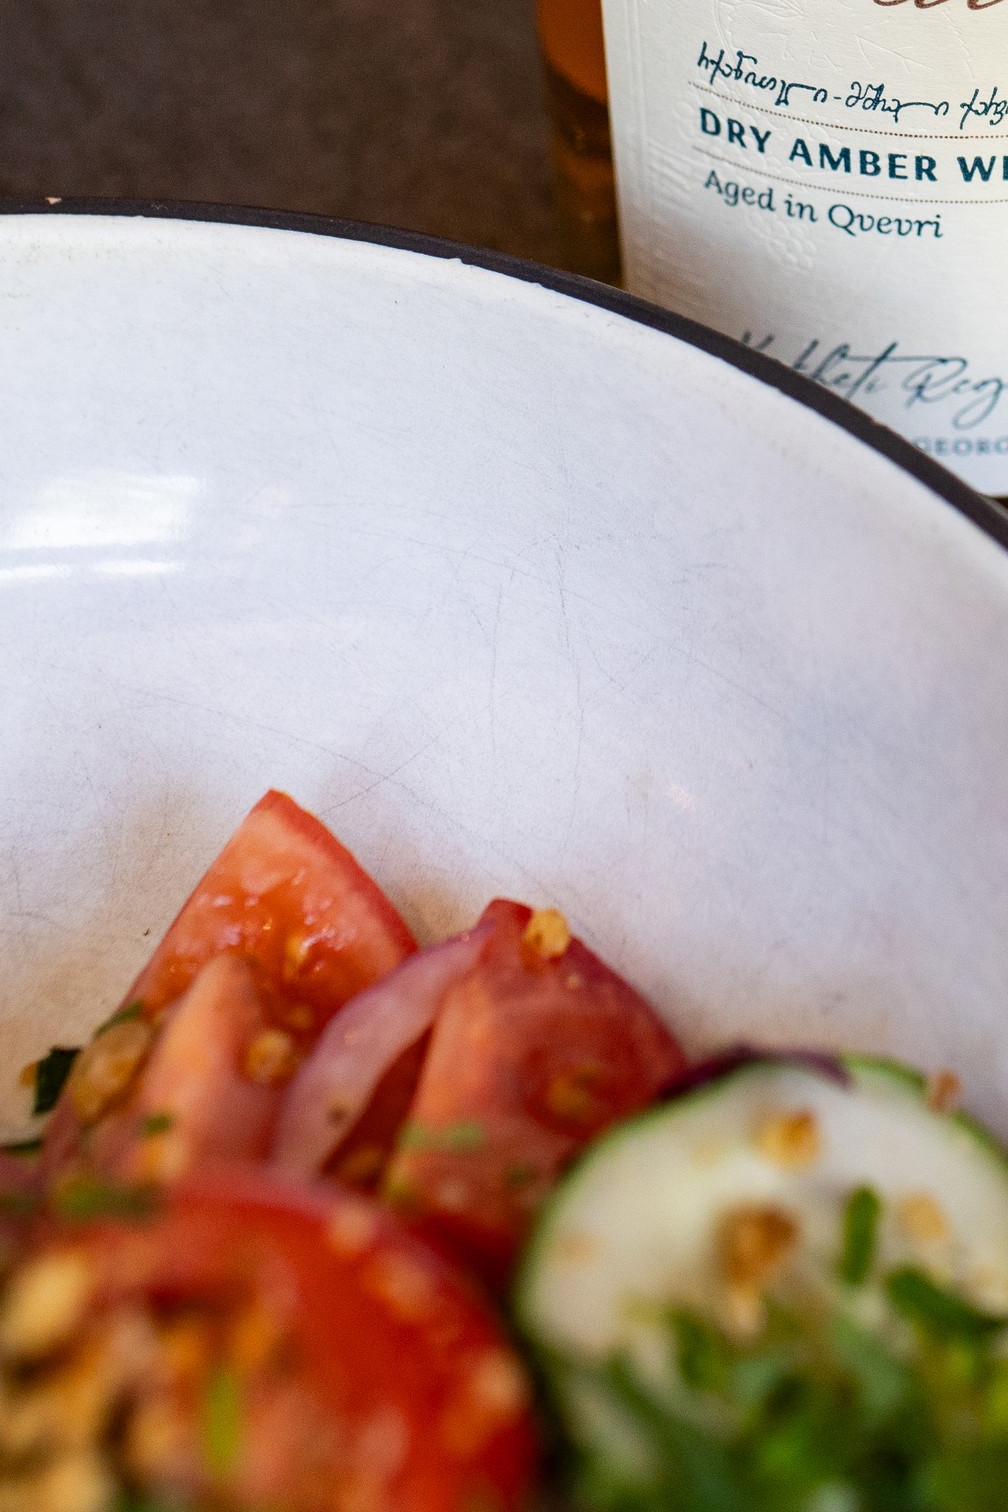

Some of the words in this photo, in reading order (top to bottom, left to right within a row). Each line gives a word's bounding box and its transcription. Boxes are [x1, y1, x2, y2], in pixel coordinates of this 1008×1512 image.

[699, 106, 772, 154] DRY
[788, 137, 938, 182] AMBER
[703, 169, 776, 212] Aged
[783, 193, 819, 224] in
[827, 203, 944, 239] Qvevri
